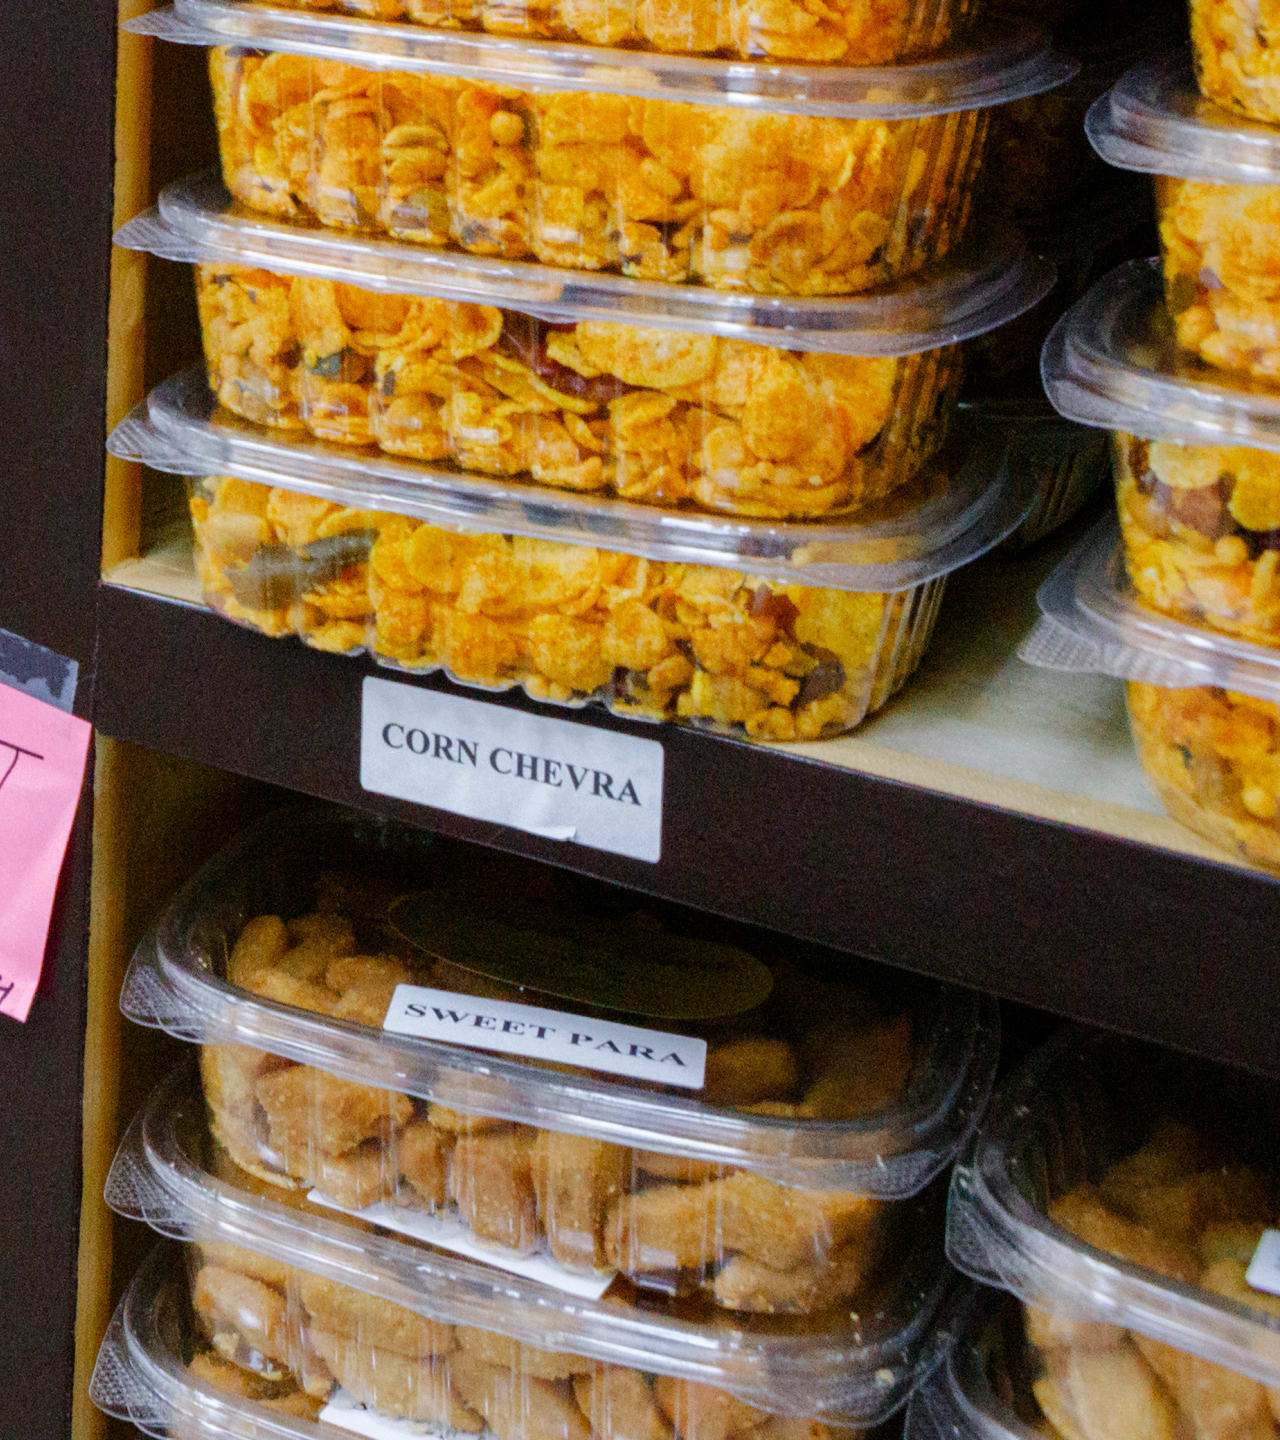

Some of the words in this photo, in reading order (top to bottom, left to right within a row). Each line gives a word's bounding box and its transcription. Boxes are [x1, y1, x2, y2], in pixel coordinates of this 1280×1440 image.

[382, 722, 480, 768] CORN
[490, 747, 642, 806] CHEVRA
[404, 1002, 556, 1041] SWEET
[569, 1030, 688, 1068] PARA
